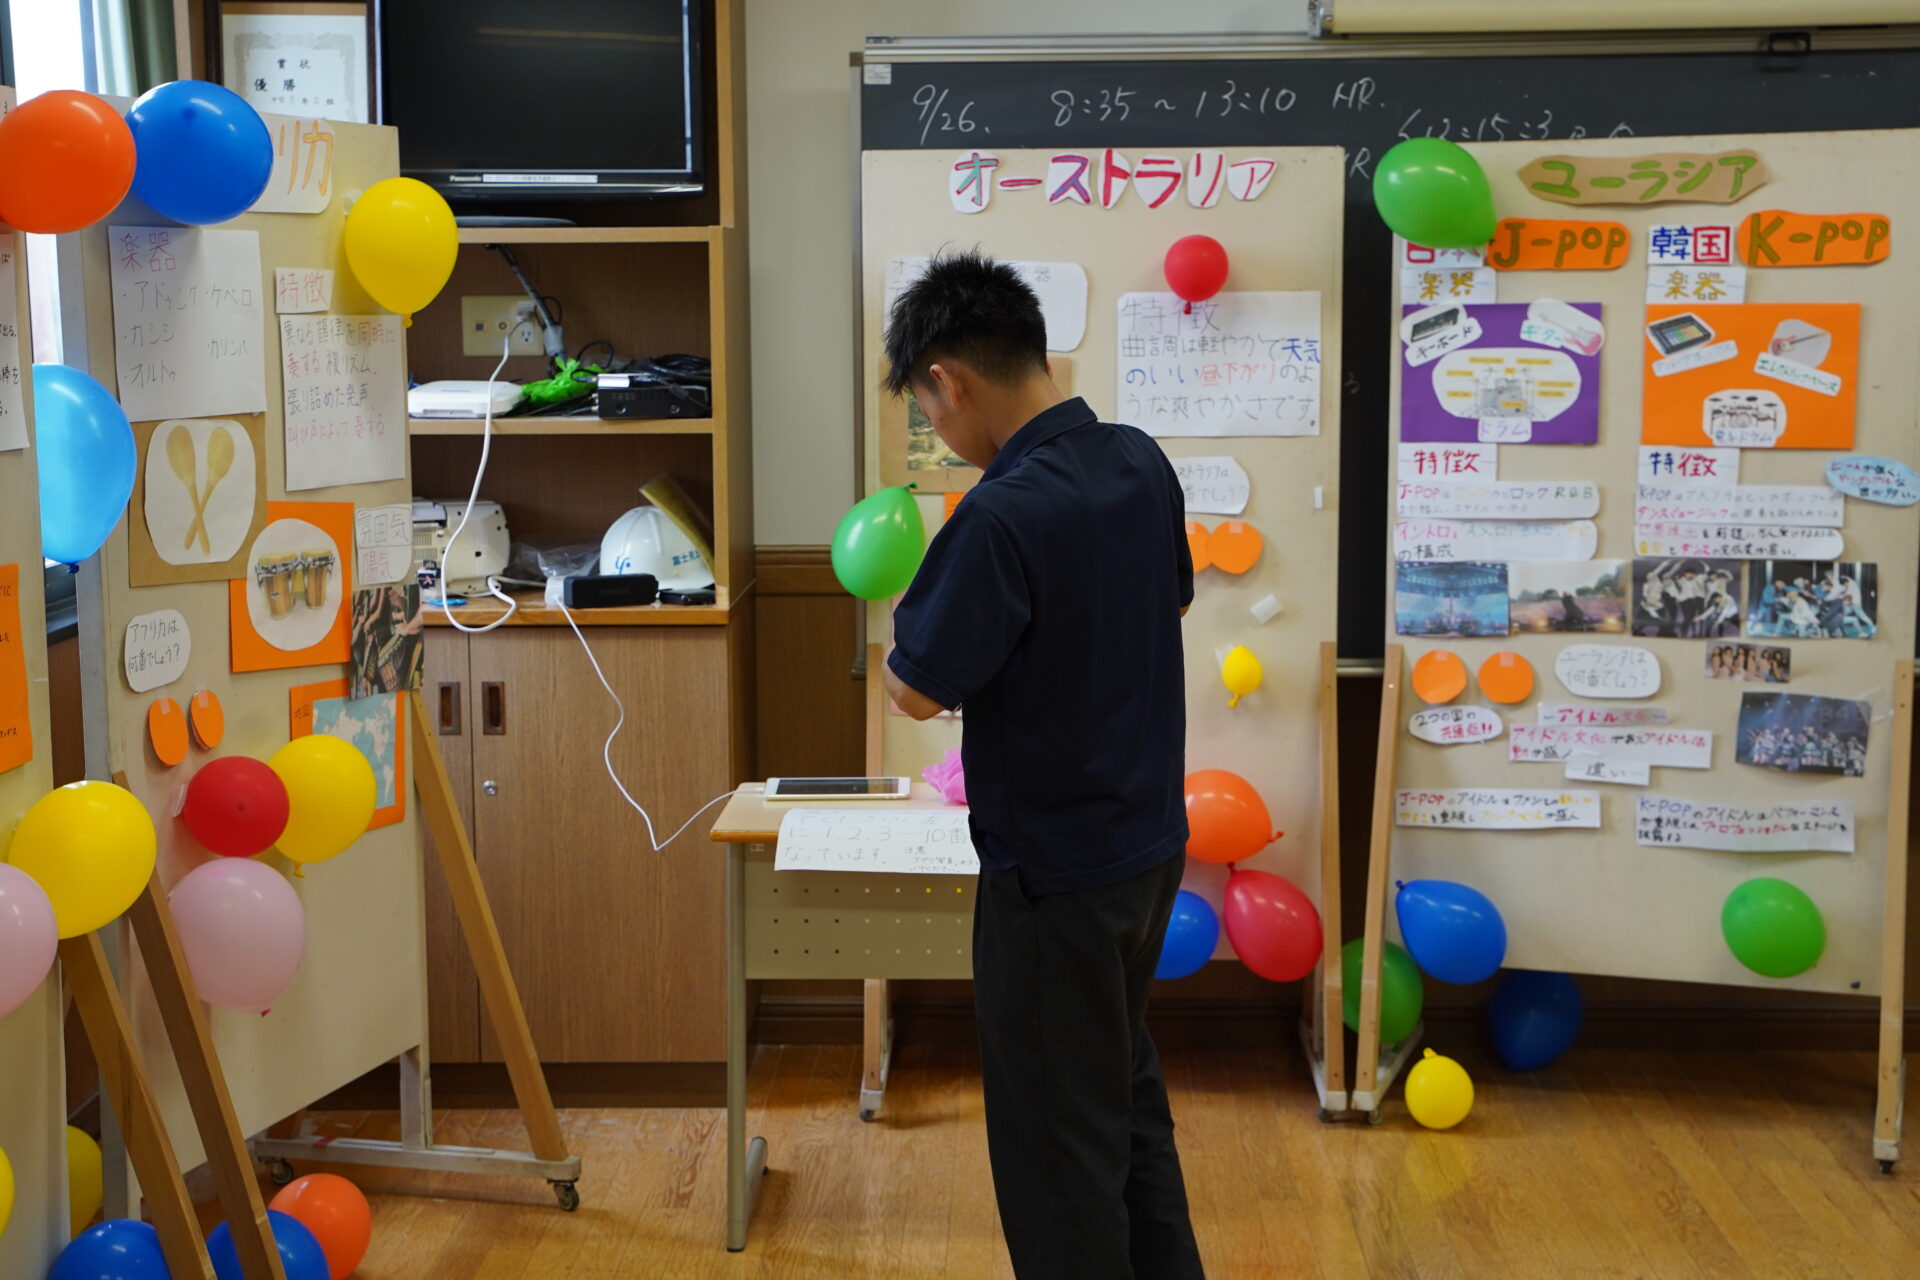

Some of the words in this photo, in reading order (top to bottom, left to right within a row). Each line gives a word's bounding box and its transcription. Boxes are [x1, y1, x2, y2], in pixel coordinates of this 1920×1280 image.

[1051, 89, 1136, 127] 8:35
[1195, 79, 1297, 118] 13:10
[270, 119, 334, 197] リカ
[1345, 147, 1371, 179] R
[954, 148, 1276, 208] オーストラリア
[1532, 155, 1757, 200] ユーラシア
[120, 231, 176, 272] 楽器
[1650, 225, 1731, 263] 韓国
[280, 270, 329, 309] 特徴
[1417, 270, 1477, 299] 楽器
[1665, 270, 1727, 300] 楽器
[1121, 333, 1321, 364] 曲調は軽やかで天気
[1125, 362, 1315, 387] のいい昼下がりのよ
[1413, 449, 1481, 475] 特徴
[1649, 451, 1718, 477] 特徴
[129, 618, 180, 642] アフリカは
[1559, 650, 1647, 668] ユーラシアは
